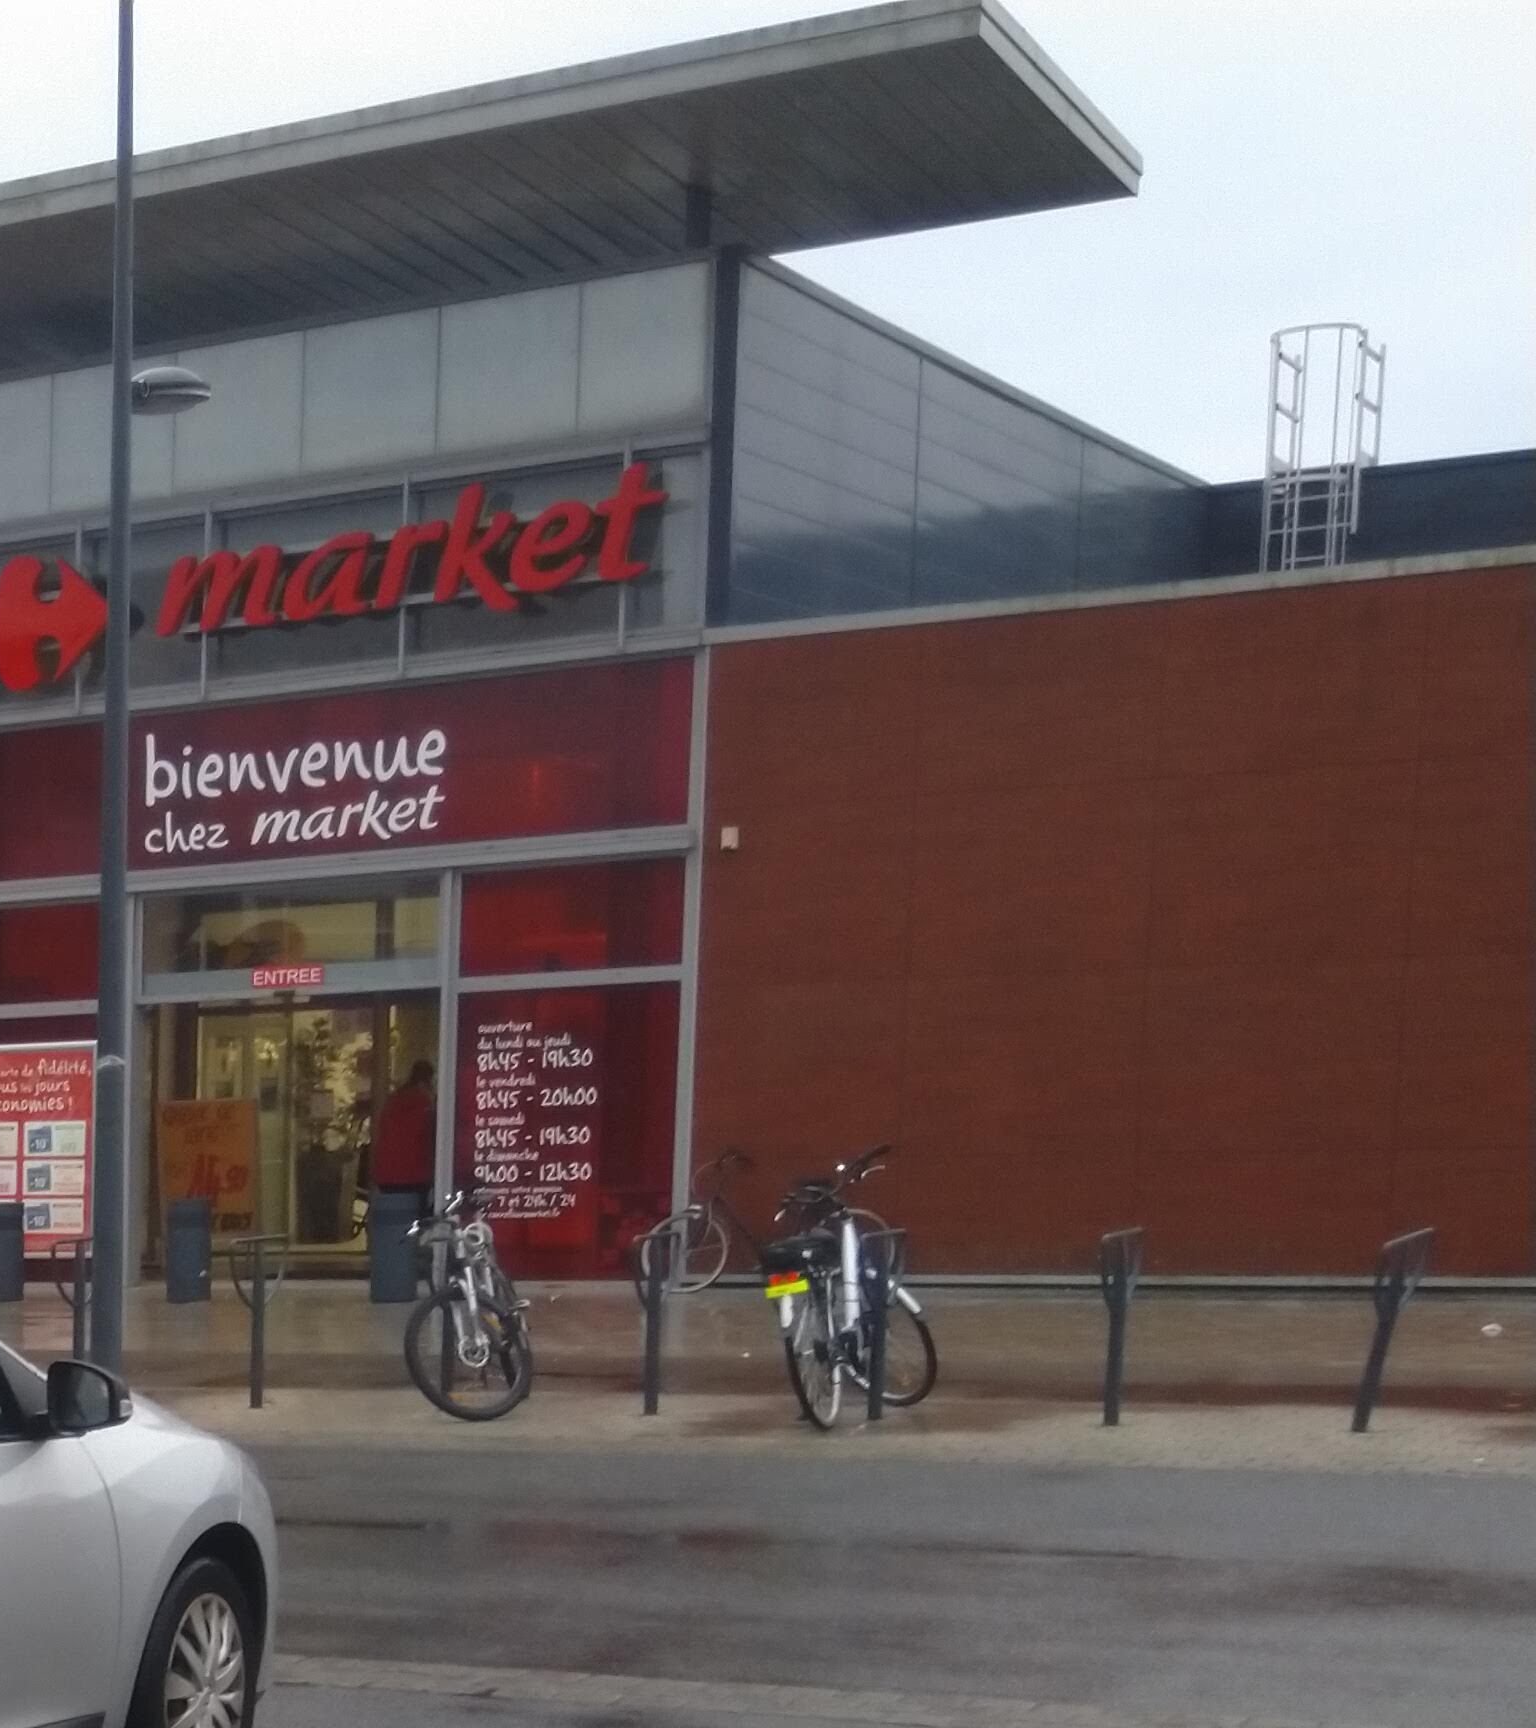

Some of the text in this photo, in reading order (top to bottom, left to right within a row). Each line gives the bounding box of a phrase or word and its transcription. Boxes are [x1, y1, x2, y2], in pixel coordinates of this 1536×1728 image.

[155, 462, 670, 637] market
[145, 729, 446, 807] bienvenue
[144, 784, 446, 853] chez market
[253, 968, 322, 986] ENTREE
[478, 1021, 532, 1034] ouverture
[477, 1032, 571, 1051] du lundi au jeudi
[21, 1063, 34, 1077] de
[37, 1058, 92, 1077] fidélité,
[477, 1052, 522, 1072] 8h45
[542, 1048, 593, 1068] 19h30
[34, 1080, 70, 1096] jours
[476, 1072, 536, 1087] le vendredi
[476, 1090, 521, 1110] 8h45
[540, 1086, 598, 1106] 20h00
[475, 1111, 525, 1126] le samedi
[475, 1128, 520, 1148] 8h45
[540, 1125, 591, 1145] 19h30
[474, 1148, 540, 1161] le dimanche
[474, 1164, 519, 1183] 9h00
[539, 1162, 592, 1181] 12h30
